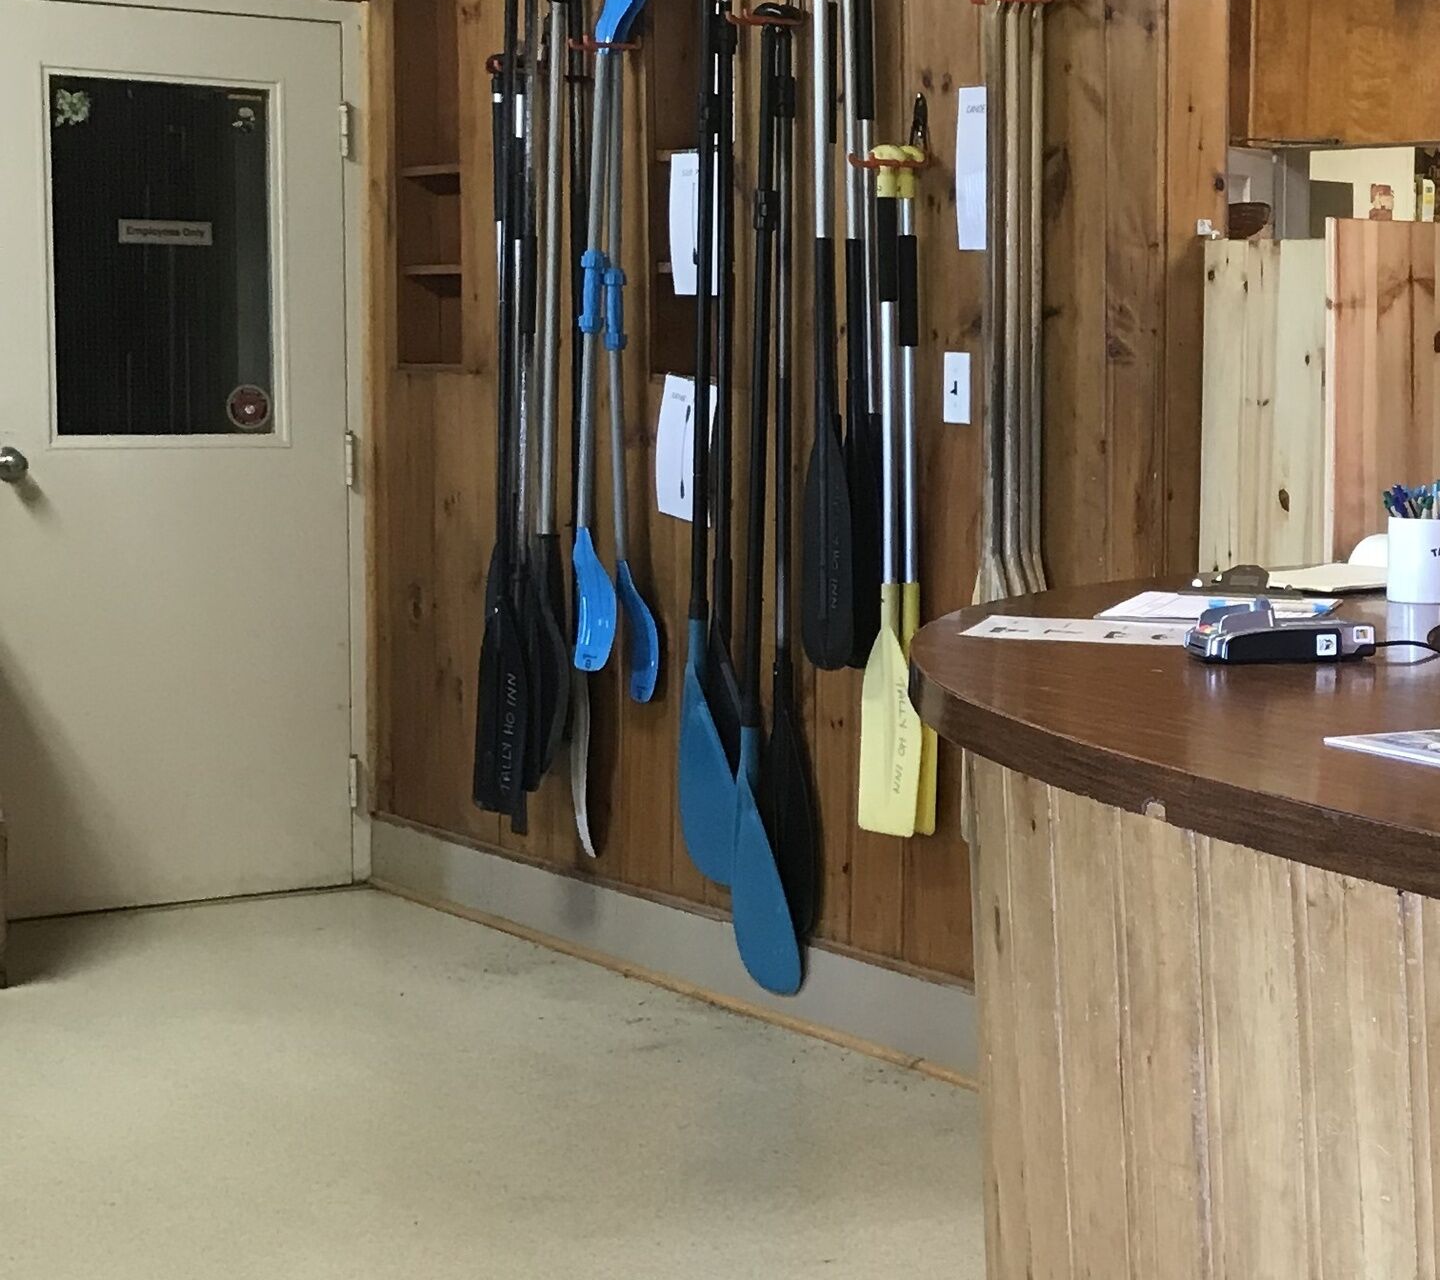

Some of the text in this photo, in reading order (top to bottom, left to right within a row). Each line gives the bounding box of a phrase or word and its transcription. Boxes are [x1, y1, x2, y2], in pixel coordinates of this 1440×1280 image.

[500, 672, 518, 791] TALLY HO INN
[891, 763, 904, 795] INN
